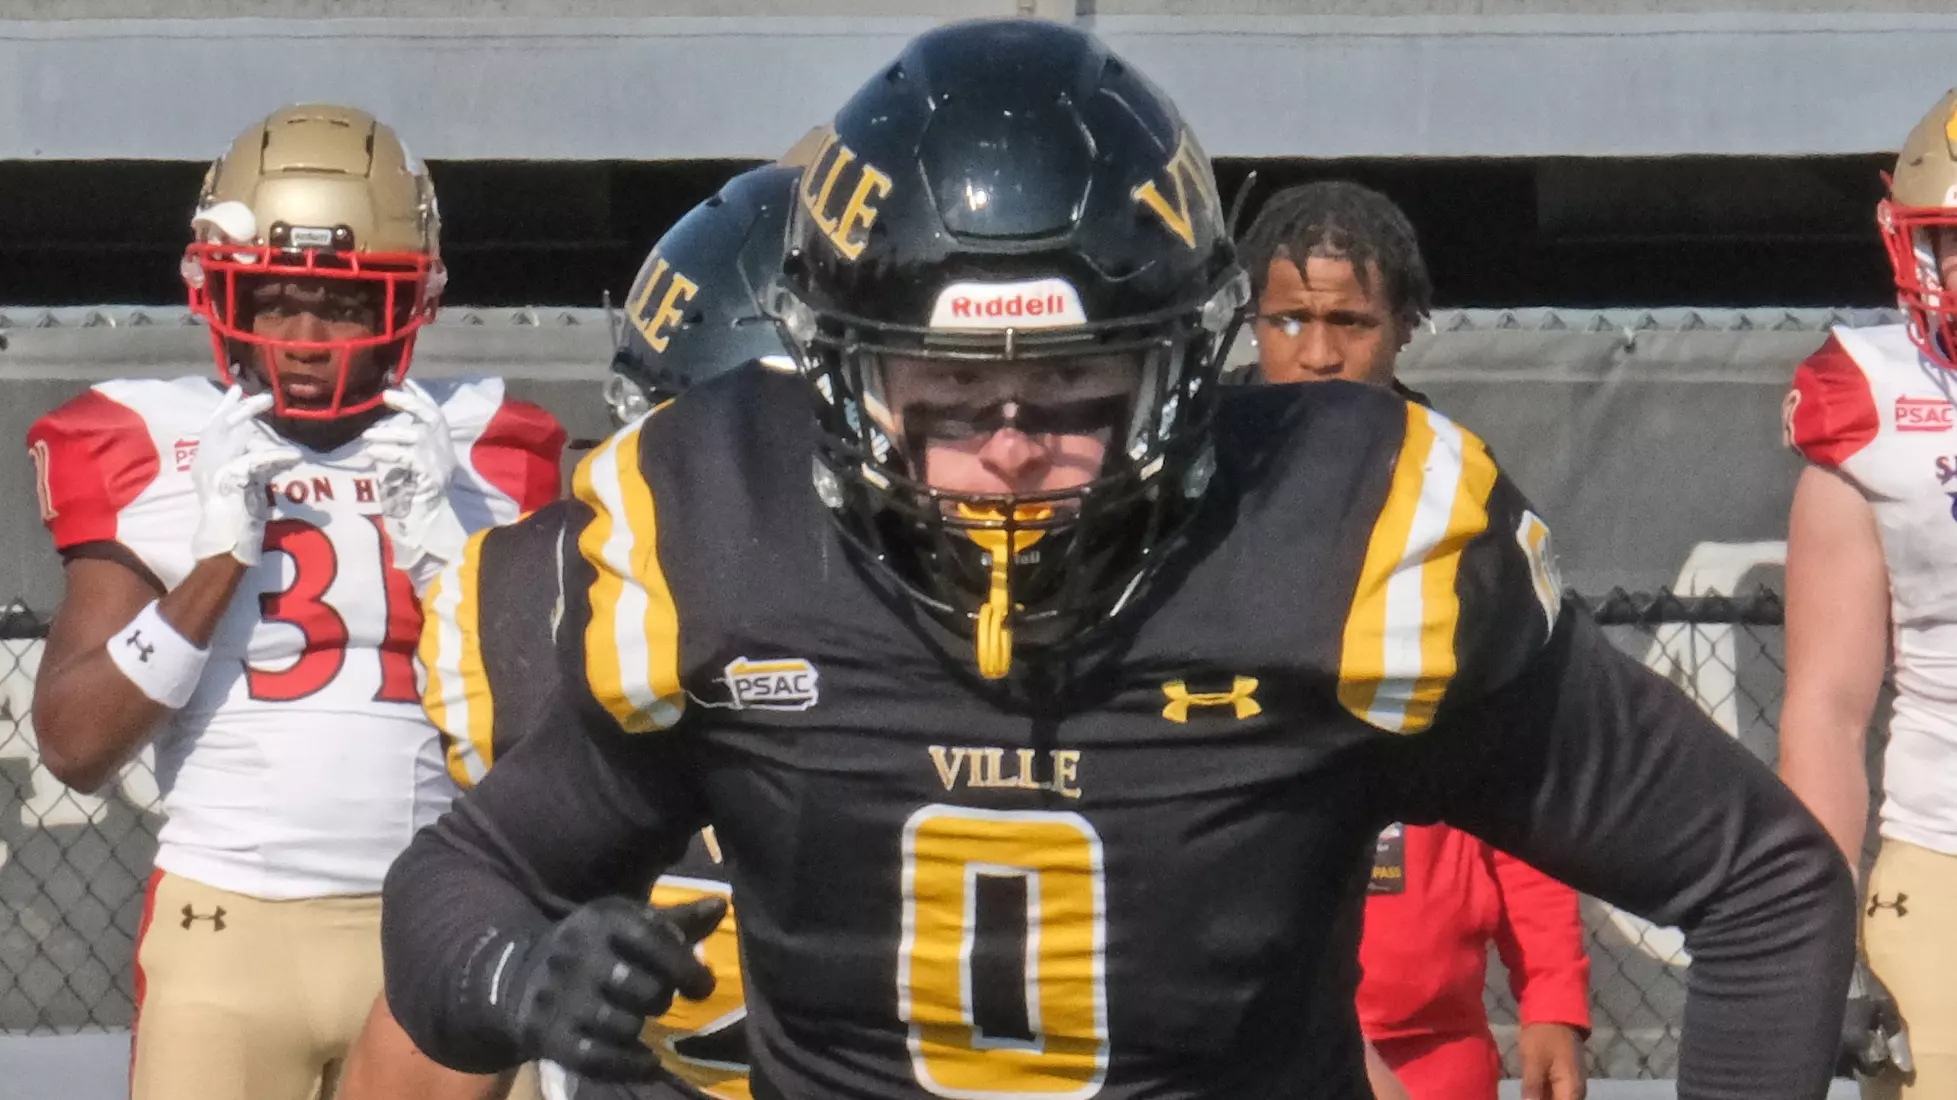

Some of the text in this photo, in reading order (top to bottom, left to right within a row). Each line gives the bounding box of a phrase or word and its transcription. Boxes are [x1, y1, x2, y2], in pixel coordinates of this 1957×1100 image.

[952, 294, 1064, 318] Riddell
[1894, 408, 1954, 424] PSAC
[242, 514, 425, 704] 31
[734, 674, 811, 696] PSAC
[928, 745, 1083, 799] VILLE
[897, 804, 1110, 1100] 0
